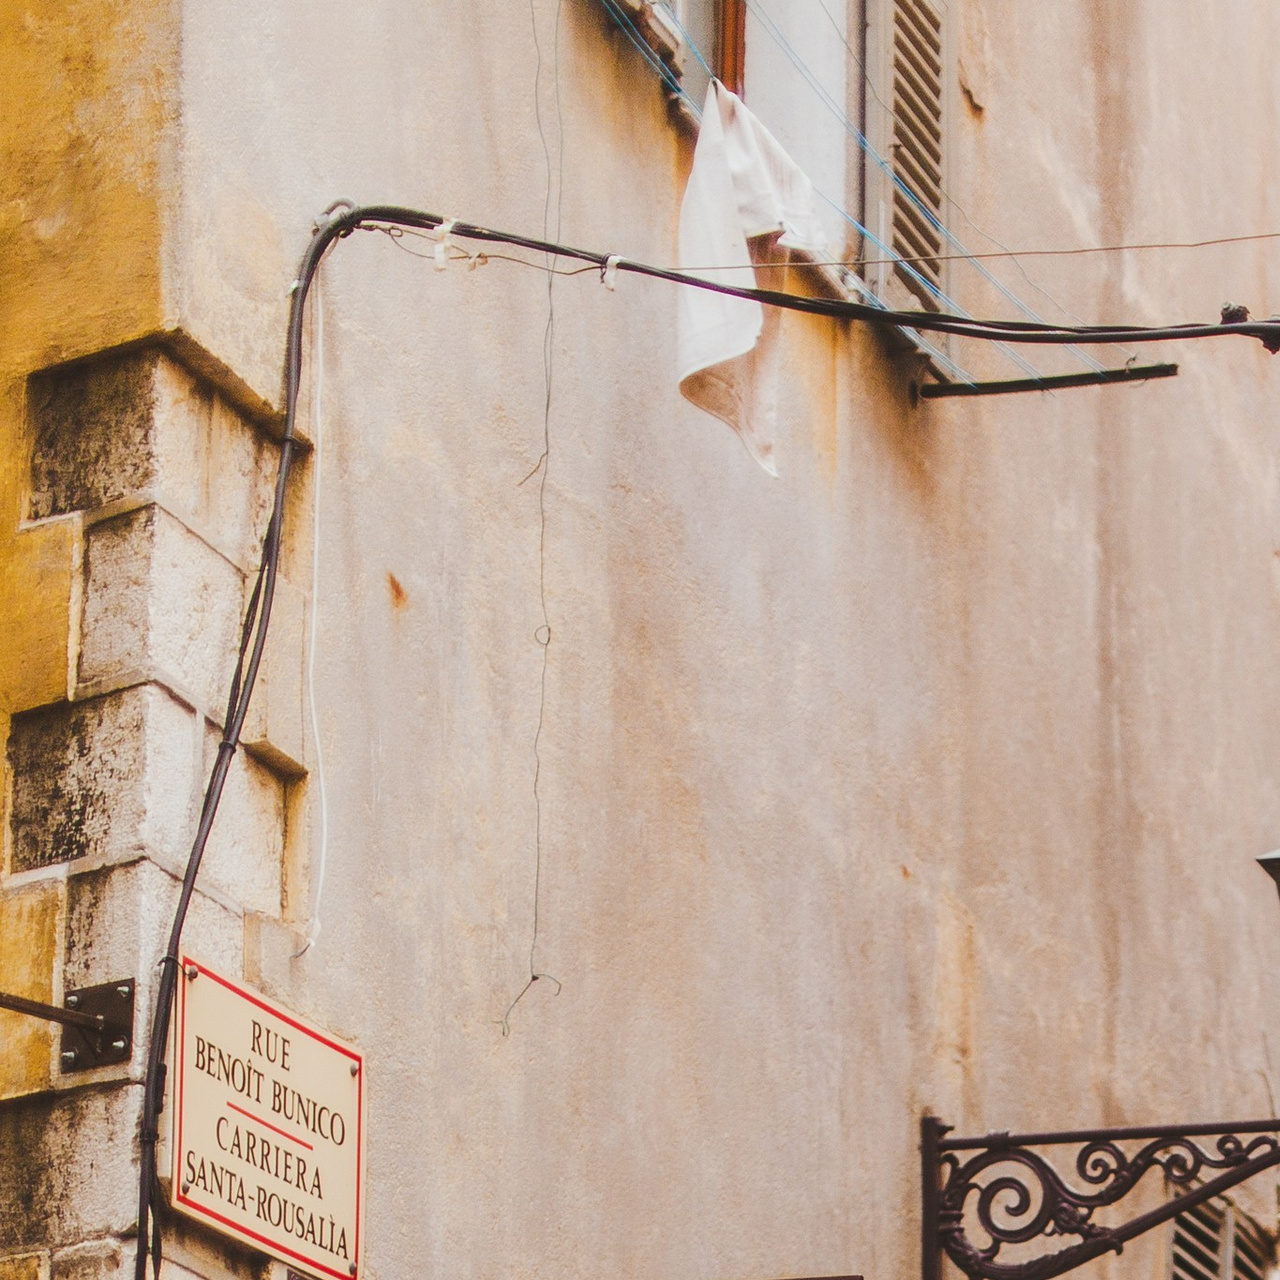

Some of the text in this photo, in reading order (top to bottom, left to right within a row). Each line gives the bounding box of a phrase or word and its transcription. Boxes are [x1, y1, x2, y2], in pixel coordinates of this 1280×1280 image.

[195, 1035, 346, 1147] BENOÎT BUNICO
[251, 1020, 291, 1072] RUE
[185, 1150, 349, 1260] SANTA-ROUSALÌA
[216, 1116, 323, 1200] CARRIERA
